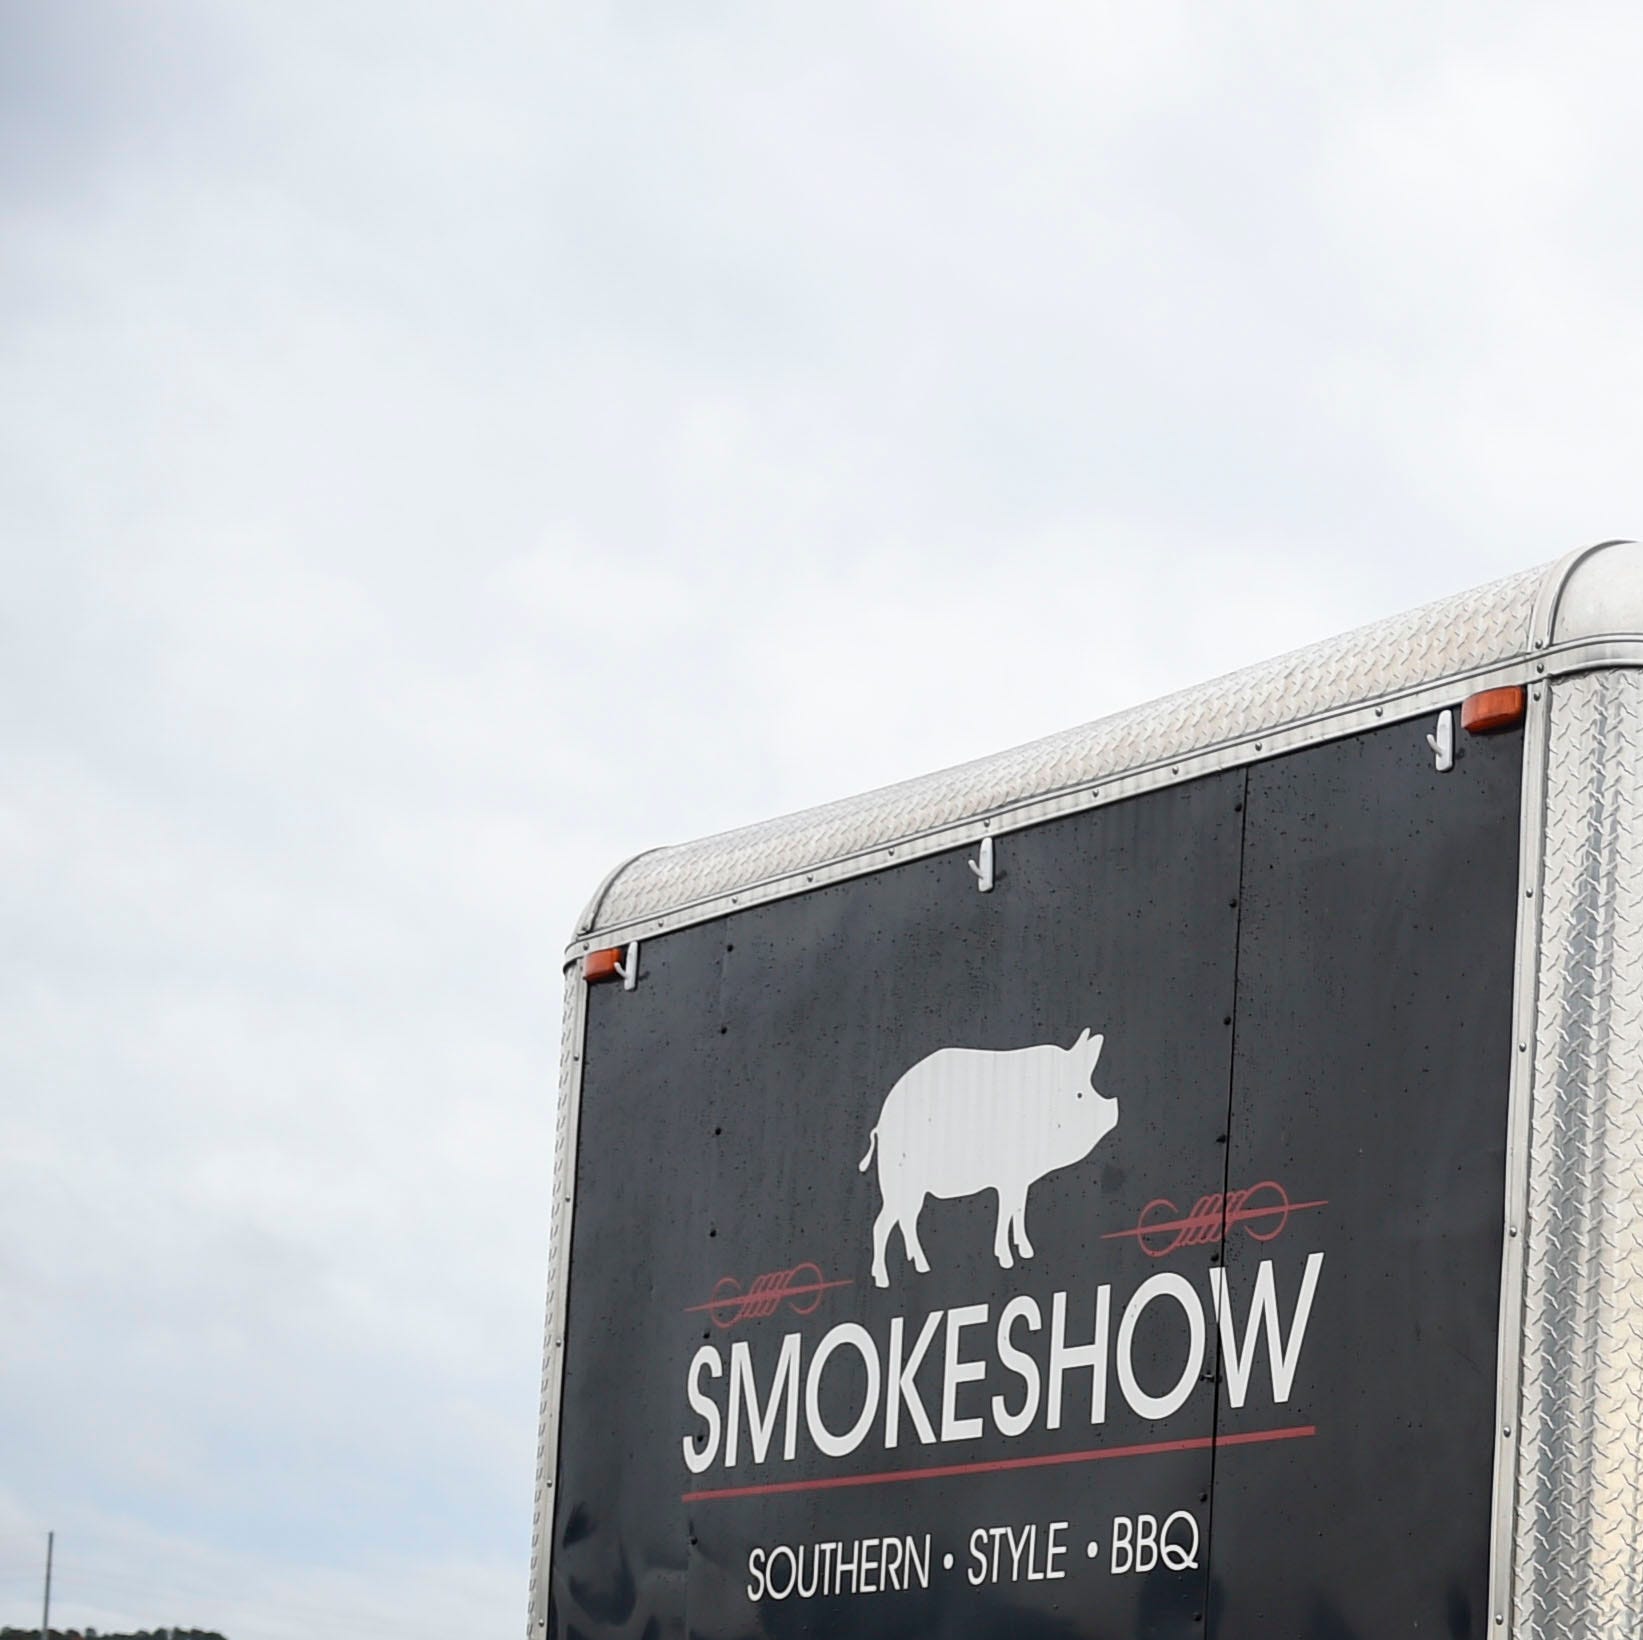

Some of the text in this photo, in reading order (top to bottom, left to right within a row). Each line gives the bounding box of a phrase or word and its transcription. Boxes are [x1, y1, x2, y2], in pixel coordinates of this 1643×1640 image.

[682, 1251, 1324, 1475] SMOKESHOW
[746, 1510, 1200, 1602] SOUTHERN STYLE BBQ
